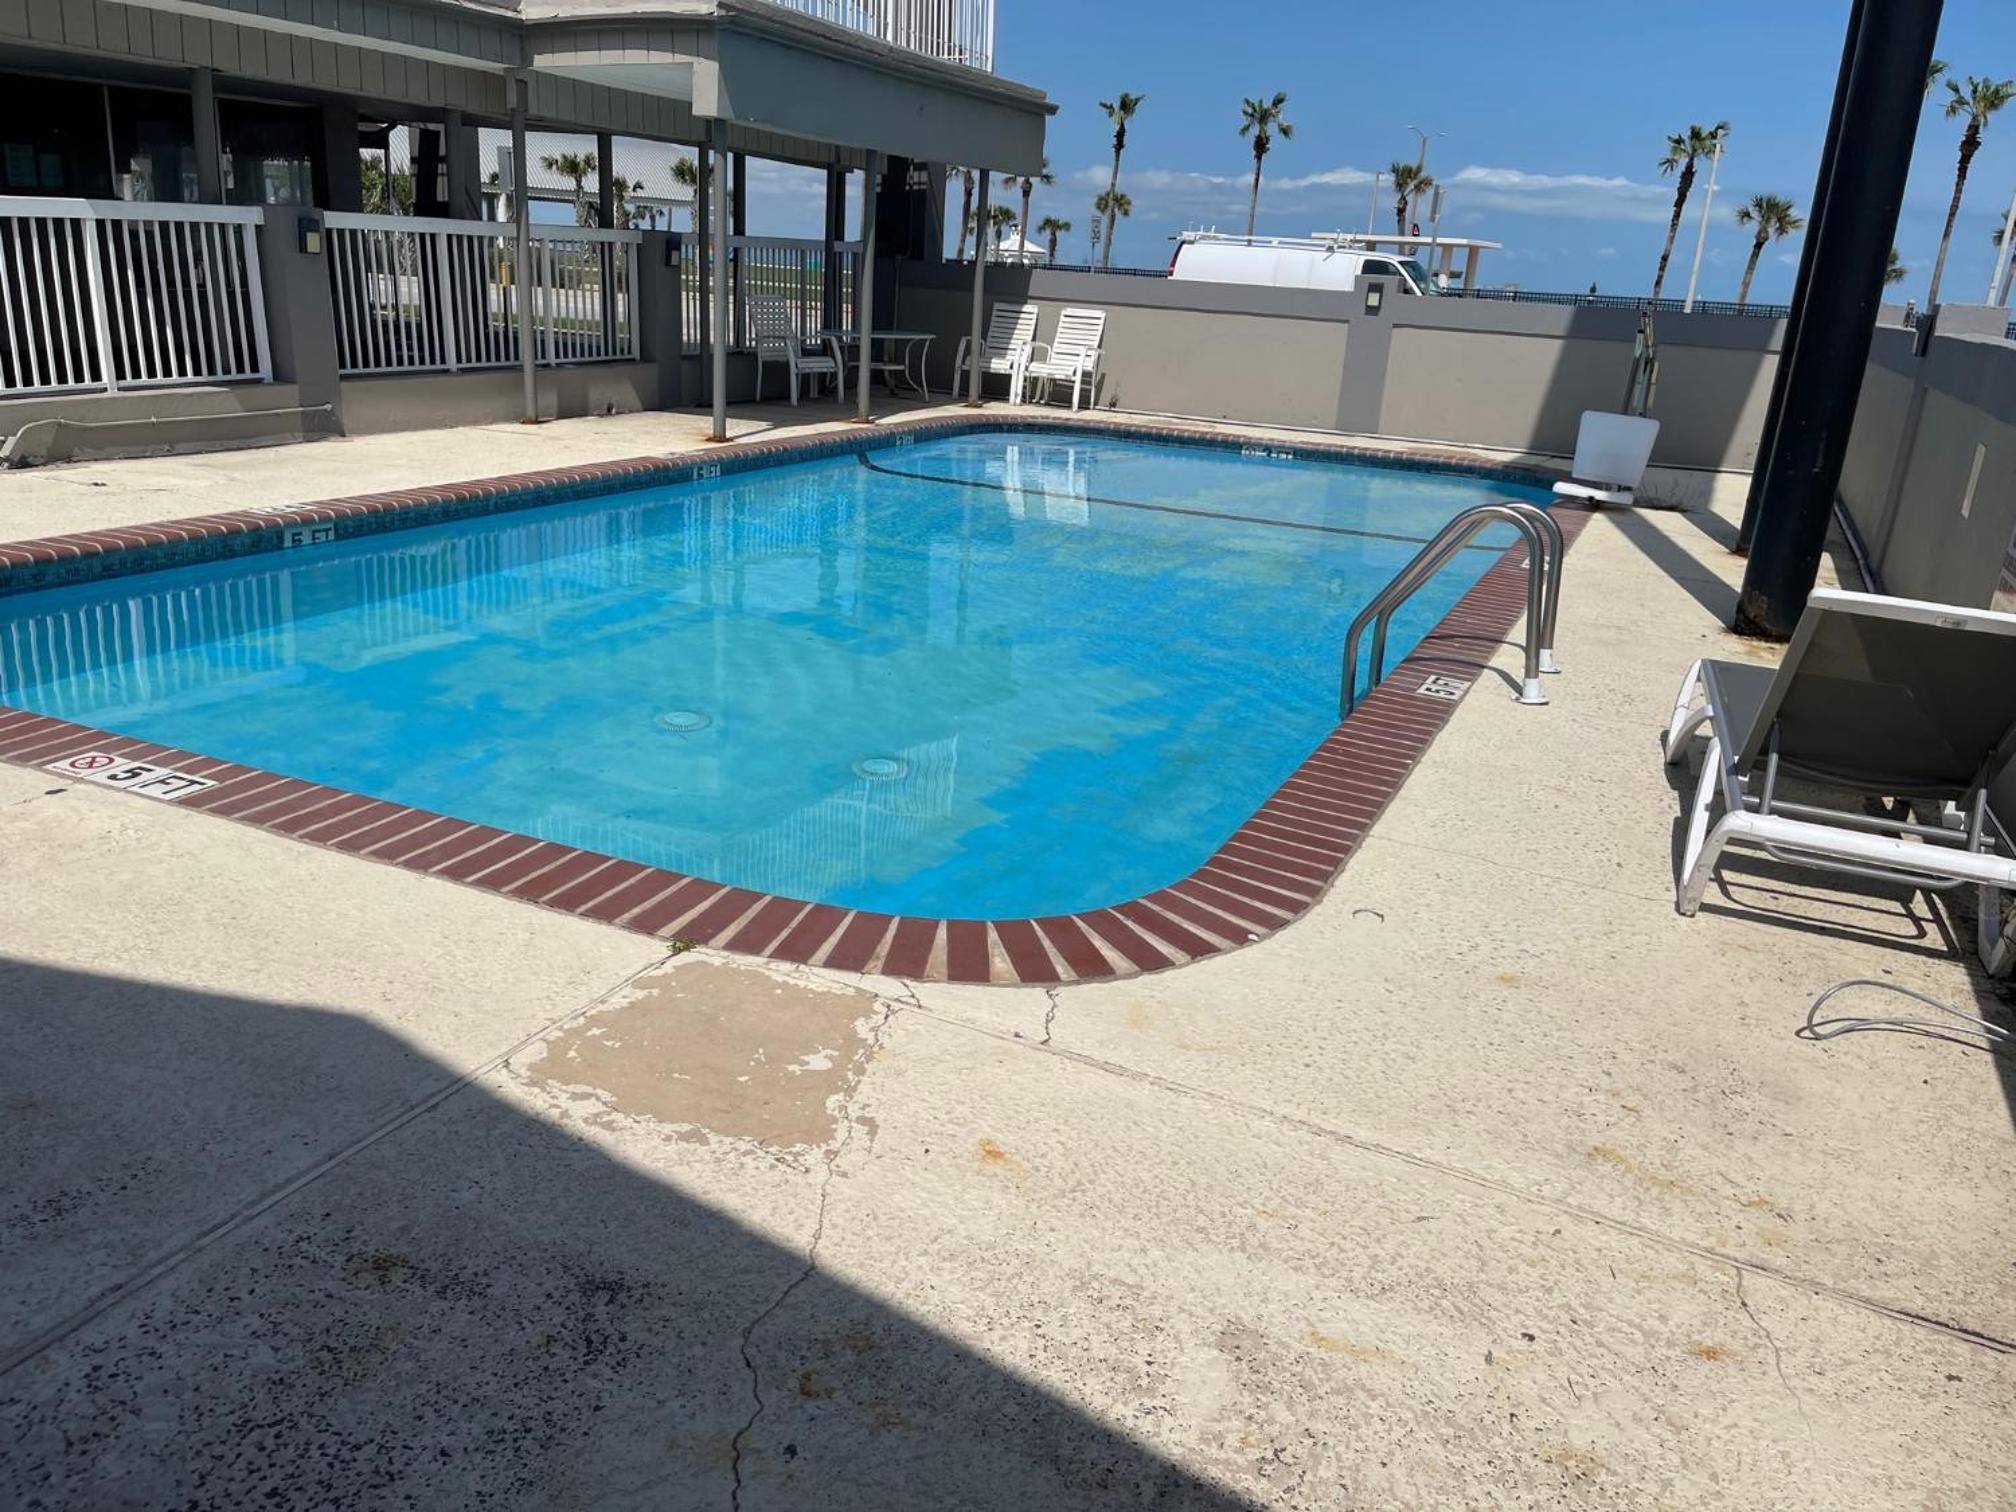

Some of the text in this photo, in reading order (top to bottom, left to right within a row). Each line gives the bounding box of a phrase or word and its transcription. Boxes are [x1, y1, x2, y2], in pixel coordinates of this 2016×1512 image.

[311, 527, 332, 542] FT
[1424, 687, 1456, 696] 5
[107, 766, 207, 795] 5 FT
